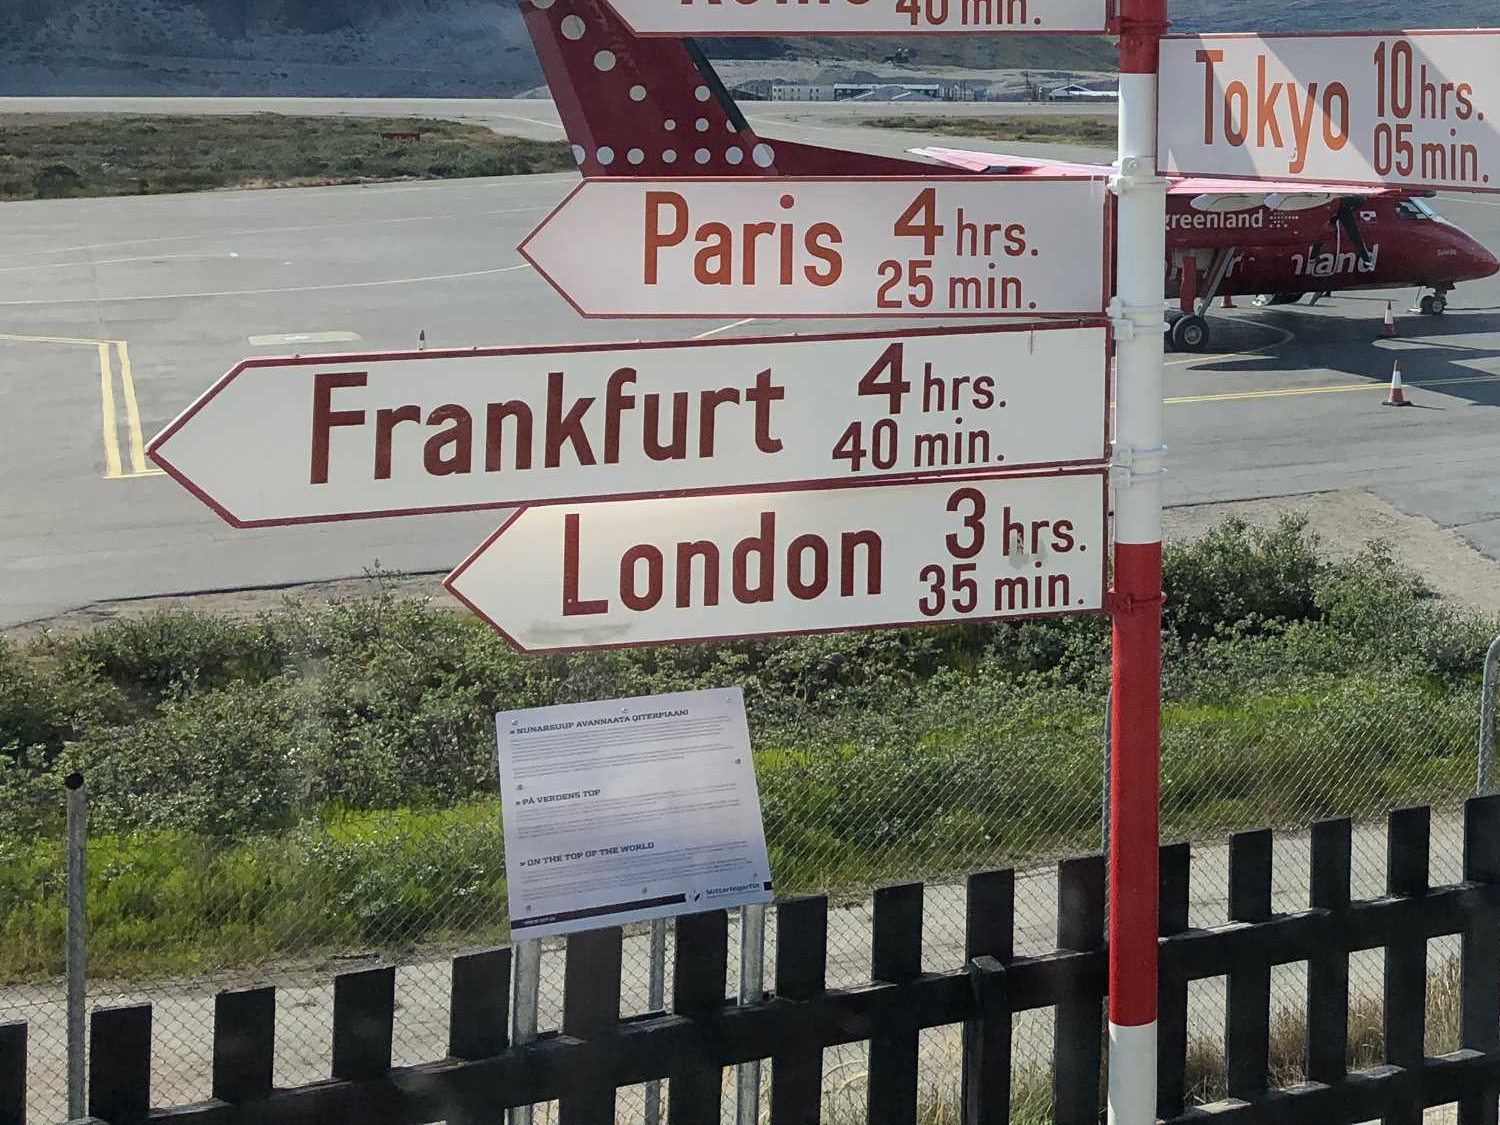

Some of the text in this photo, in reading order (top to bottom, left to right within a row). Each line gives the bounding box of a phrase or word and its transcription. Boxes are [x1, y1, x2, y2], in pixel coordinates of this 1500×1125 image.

[1195, 40, 1485, 175] Tokyo 10 hrs.
[1373, 122, 1490, 184] 05 min.
[643, 187, 1040, 287] Paris 4 hrs.
[876, 260, 1038, 310] 25 min.
[309, 342, 1008, 485] Frankfurt 4 hrs.
[831, 418, 1005, 472] 40 min.
[562, 487, 1088, 618] London 3 hrs.
[917, 560, 1086, 618] 35 min.
[527, 841, 655, 867] ON THE TOP OF THE WORLD
